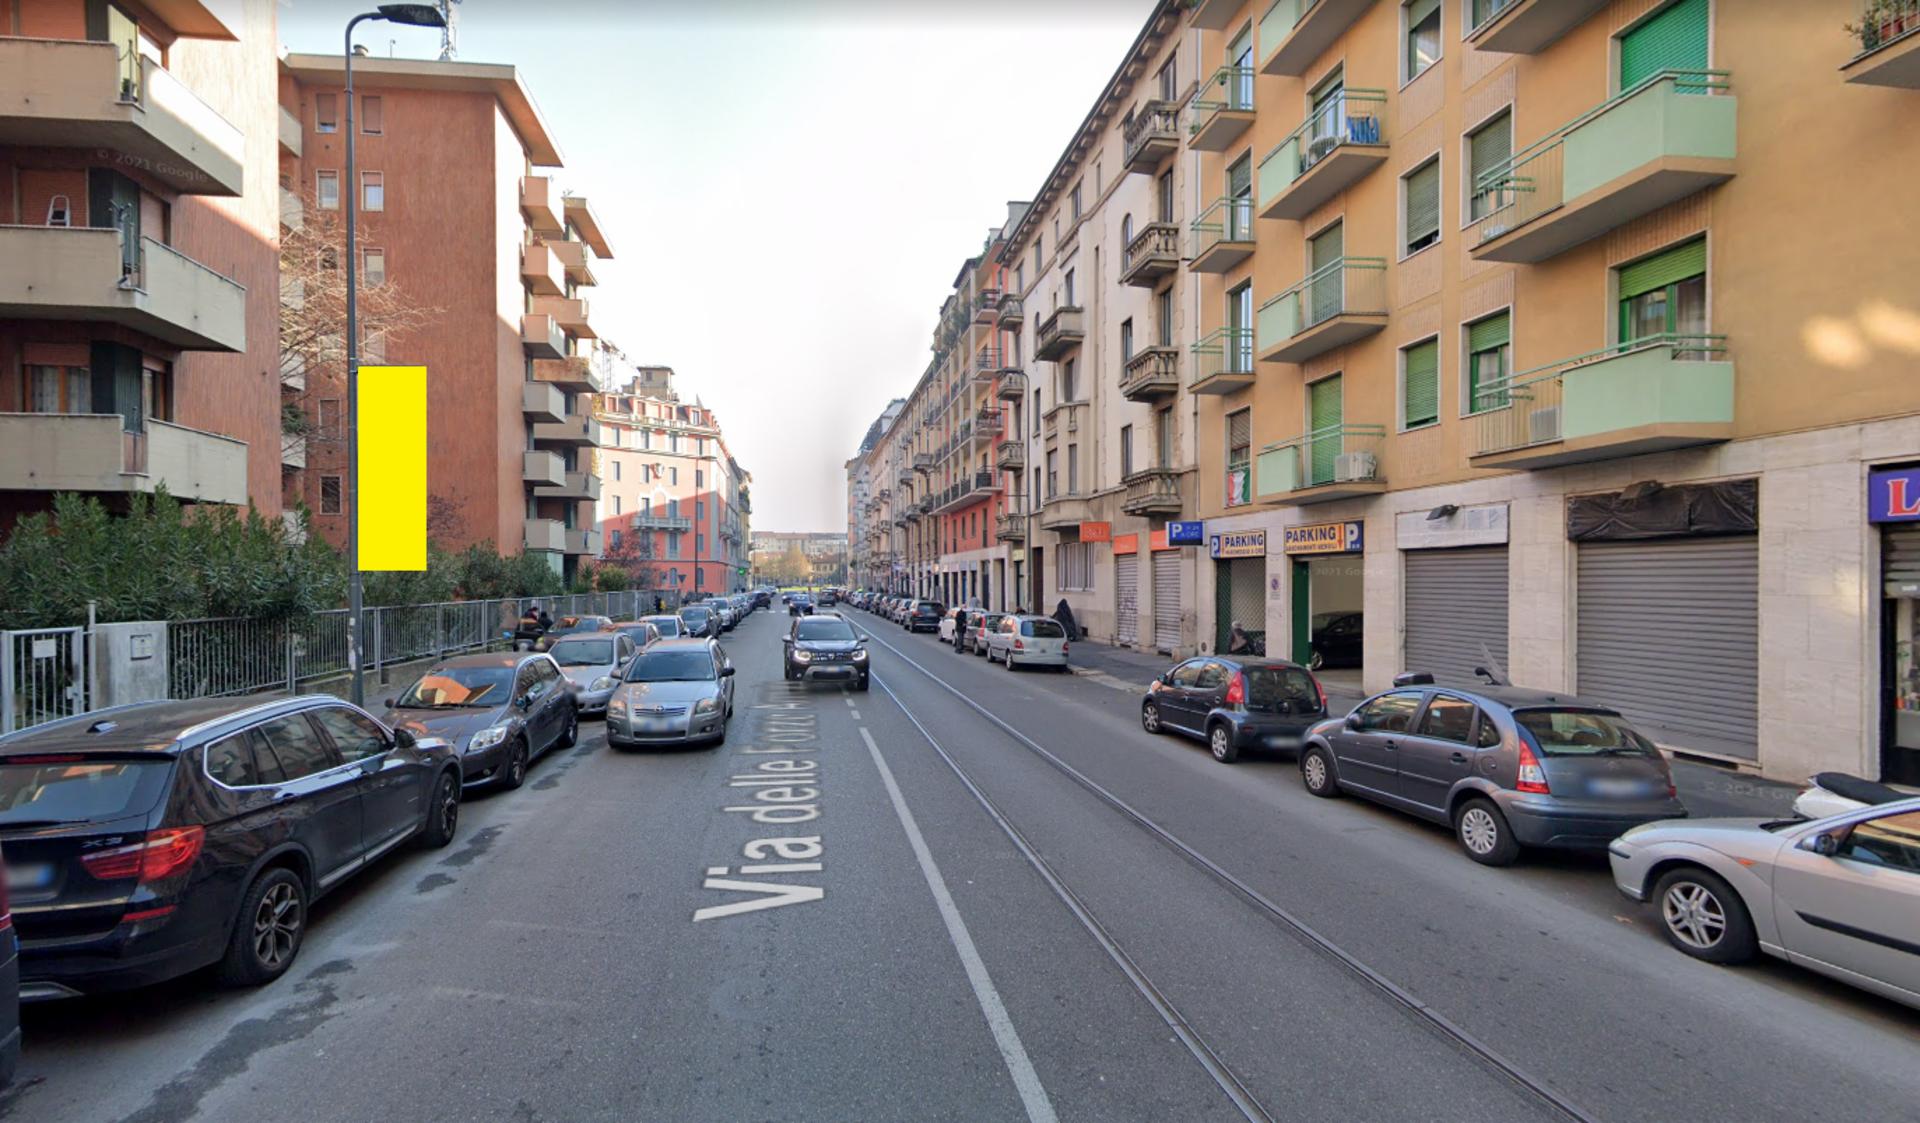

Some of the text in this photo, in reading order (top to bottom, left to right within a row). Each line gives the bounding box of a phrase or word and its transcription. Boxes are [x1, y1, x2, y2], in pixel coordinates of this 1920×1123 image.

[1172, 524, 1182, 538] P
[1286, 526, 1336, 543] PARKING
[1346, 523, 1359, 549] P
[1212, 537, 1219, 558] P
[1225, 534, 1264, 548] PARKING
